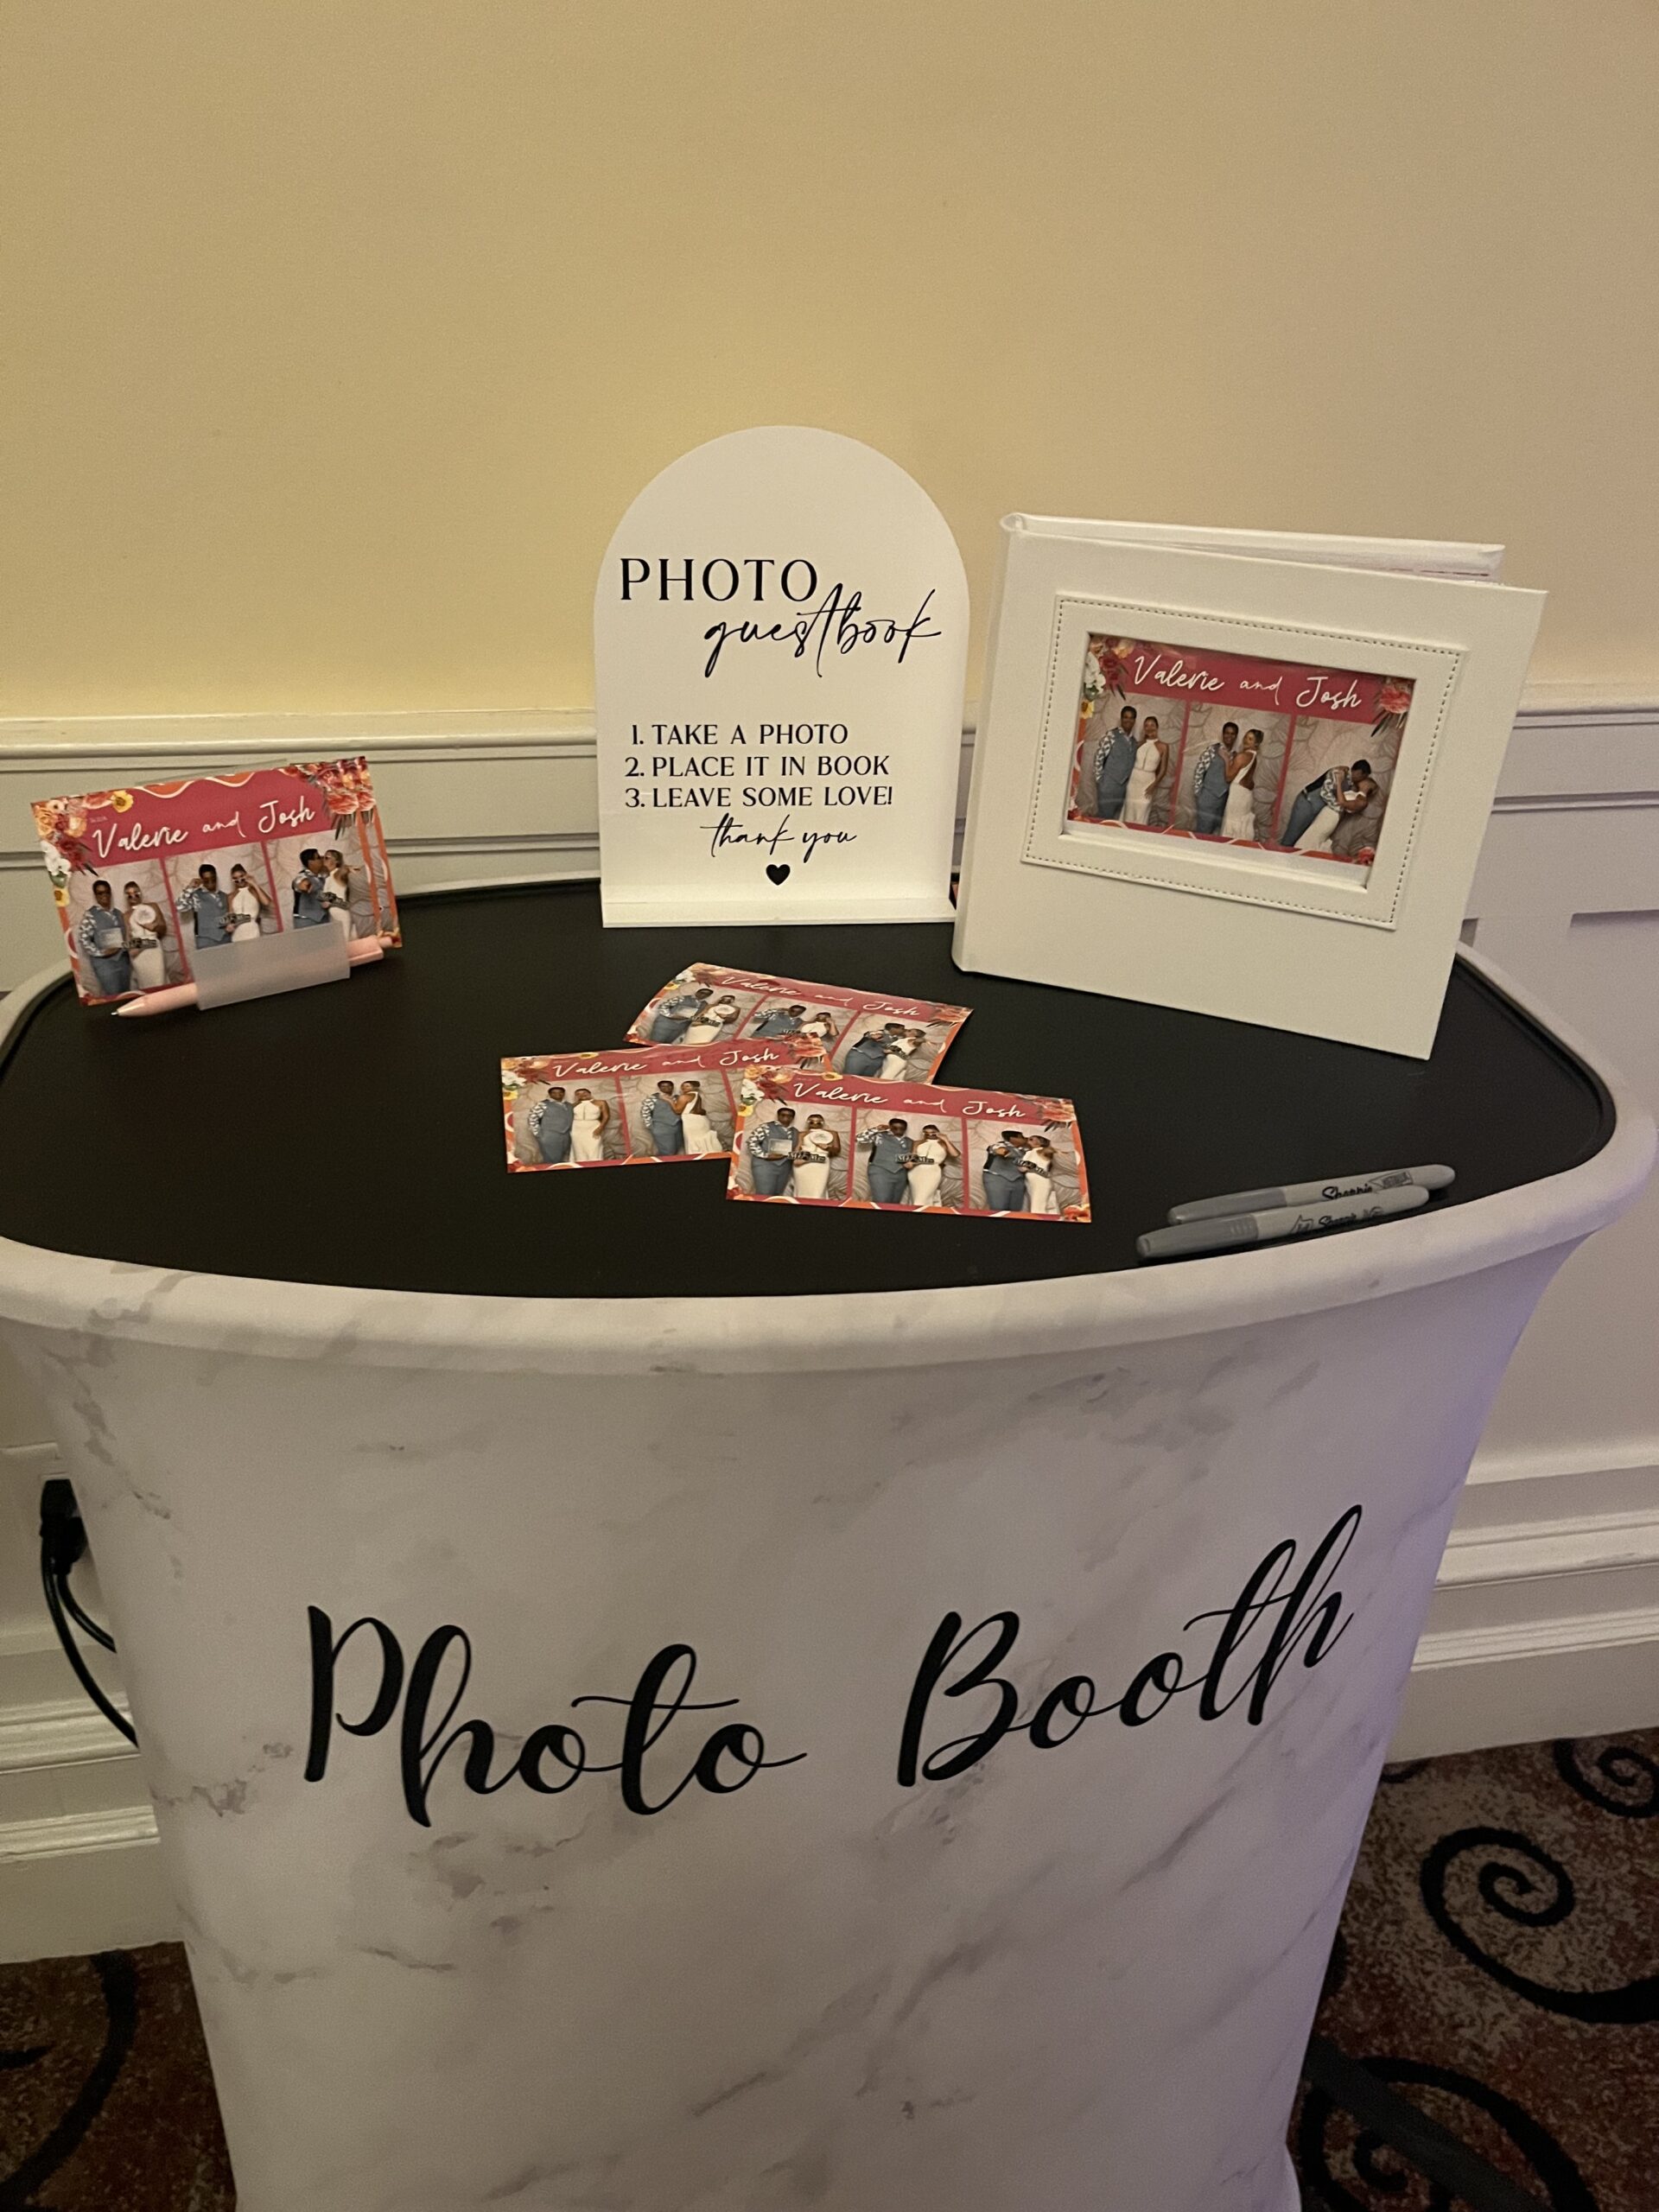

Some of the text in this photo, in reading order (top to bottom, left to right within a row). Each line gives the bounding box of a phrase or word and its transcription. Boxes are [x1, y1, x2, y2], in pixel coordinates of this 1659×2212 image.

[620, 558, 817, 601] PHOTO
[703, 582, 941, 677] guestbook
[1135, 656, 1361, 709] Valerie and Josh
[632, 724, 848, 744] 1. TAKE A PHOTO
[626, 756, 889, 777] 2. PLACE IT IN BOOK
[626, 786, 892, 807] 3. LEAVE SOME LOVE!
[92, 795, 315, 858] Valerie and Josh
[701, 813, 856, 863] thank you
[721, 976, 920, 1016] Valerie and Josh
[553, 1047, 779, 1077] Valerie and Josh
[793, 1082, 1026, 1118] Valerie and Josh
[305, 1505, 1362, 1827] Photo Booth
